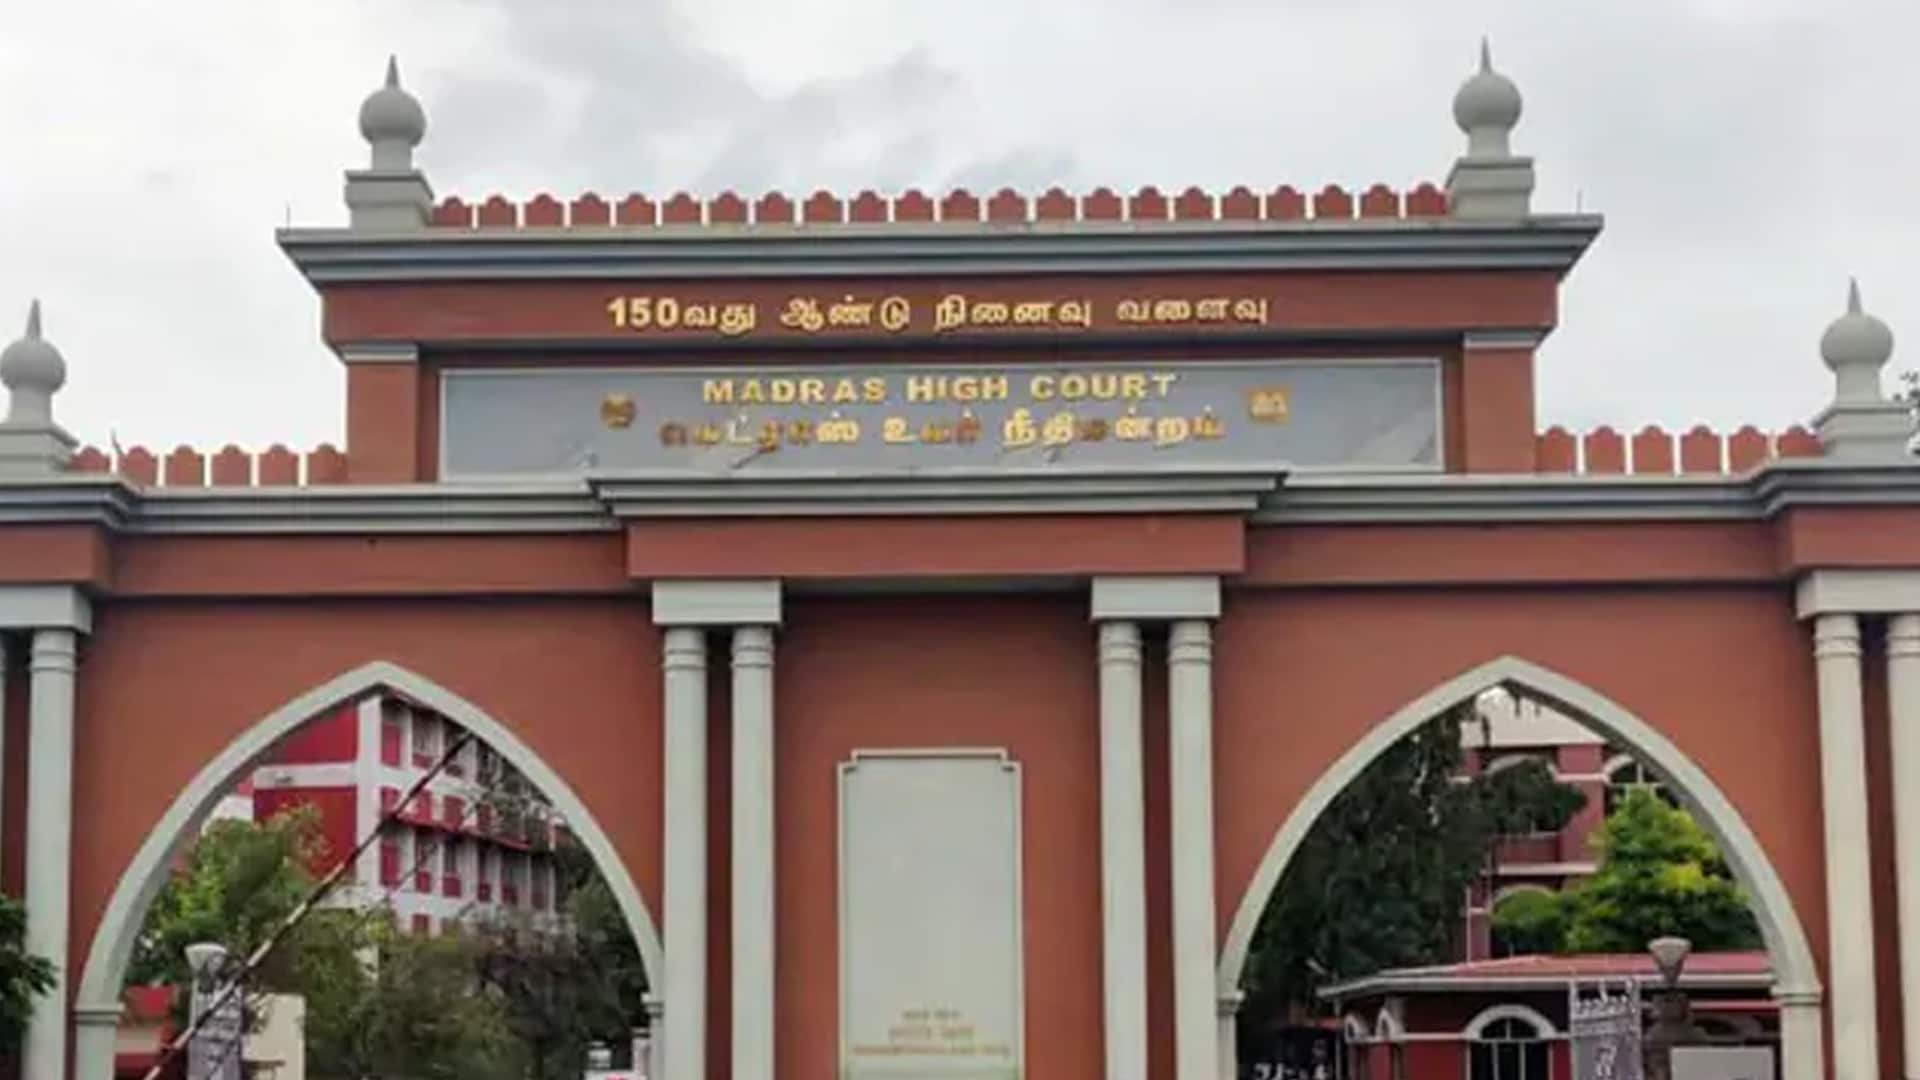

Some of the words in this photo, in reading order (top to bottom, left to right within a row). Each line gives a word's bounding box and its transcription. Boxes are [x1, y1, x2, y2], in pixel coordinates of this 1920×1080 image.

[607, 296, 756, 335] 150வது
[780, 294, 911, 331] ஆண்டு
[934, 294, 1092, 331] நினைவு
[1116, 297, 1268, 325] வளைவு
[703, 376, 887, 403] MADRAS
[907, 375, 1009, 401] HIGH
[1030, 372, 1177, 399] COURT
